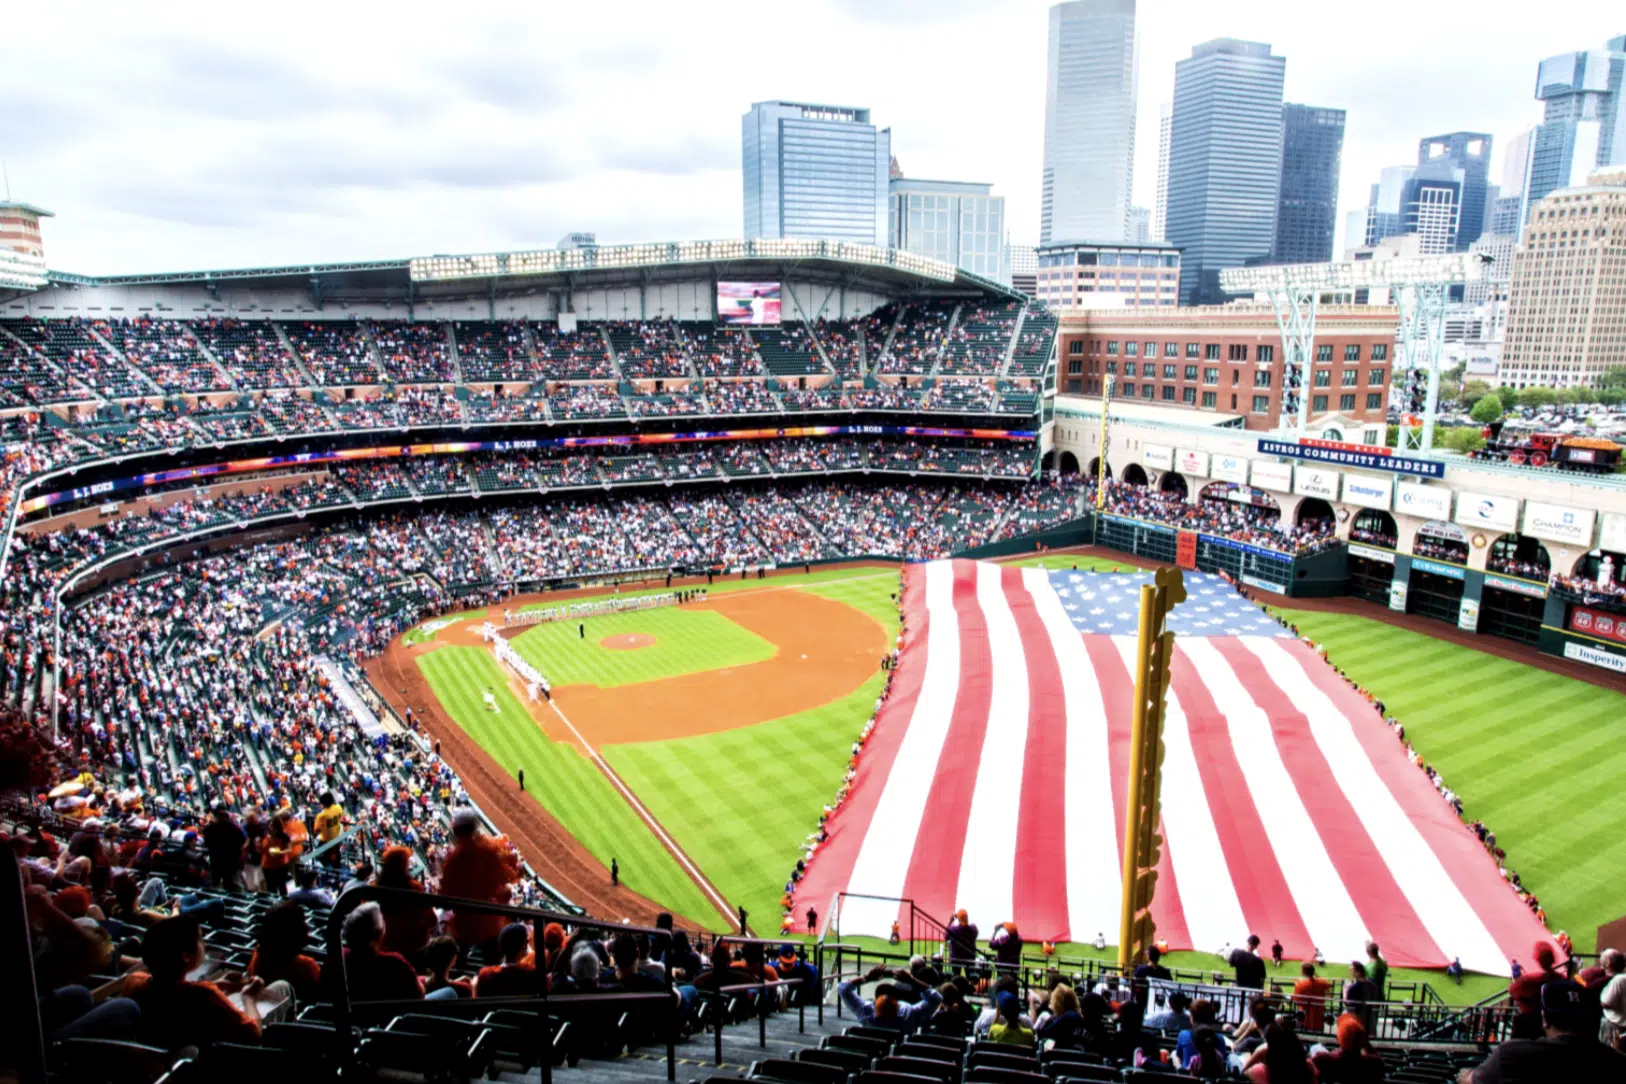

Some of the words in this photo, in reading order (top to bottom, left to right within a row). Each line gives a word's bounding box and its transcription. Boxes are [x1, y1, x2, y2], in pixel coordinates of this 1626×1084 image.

[1263, 442, 1300, 455] ASTROS
[1304, 448, 1376, 466] COMMUNITY
[1380, 458, 1437, 474] LEADERS
[90, 481, 114, 495] HOES
[1533, 519, 1582, 533] CHAMPION
[1579, 648, 1625, 668] Insperity
